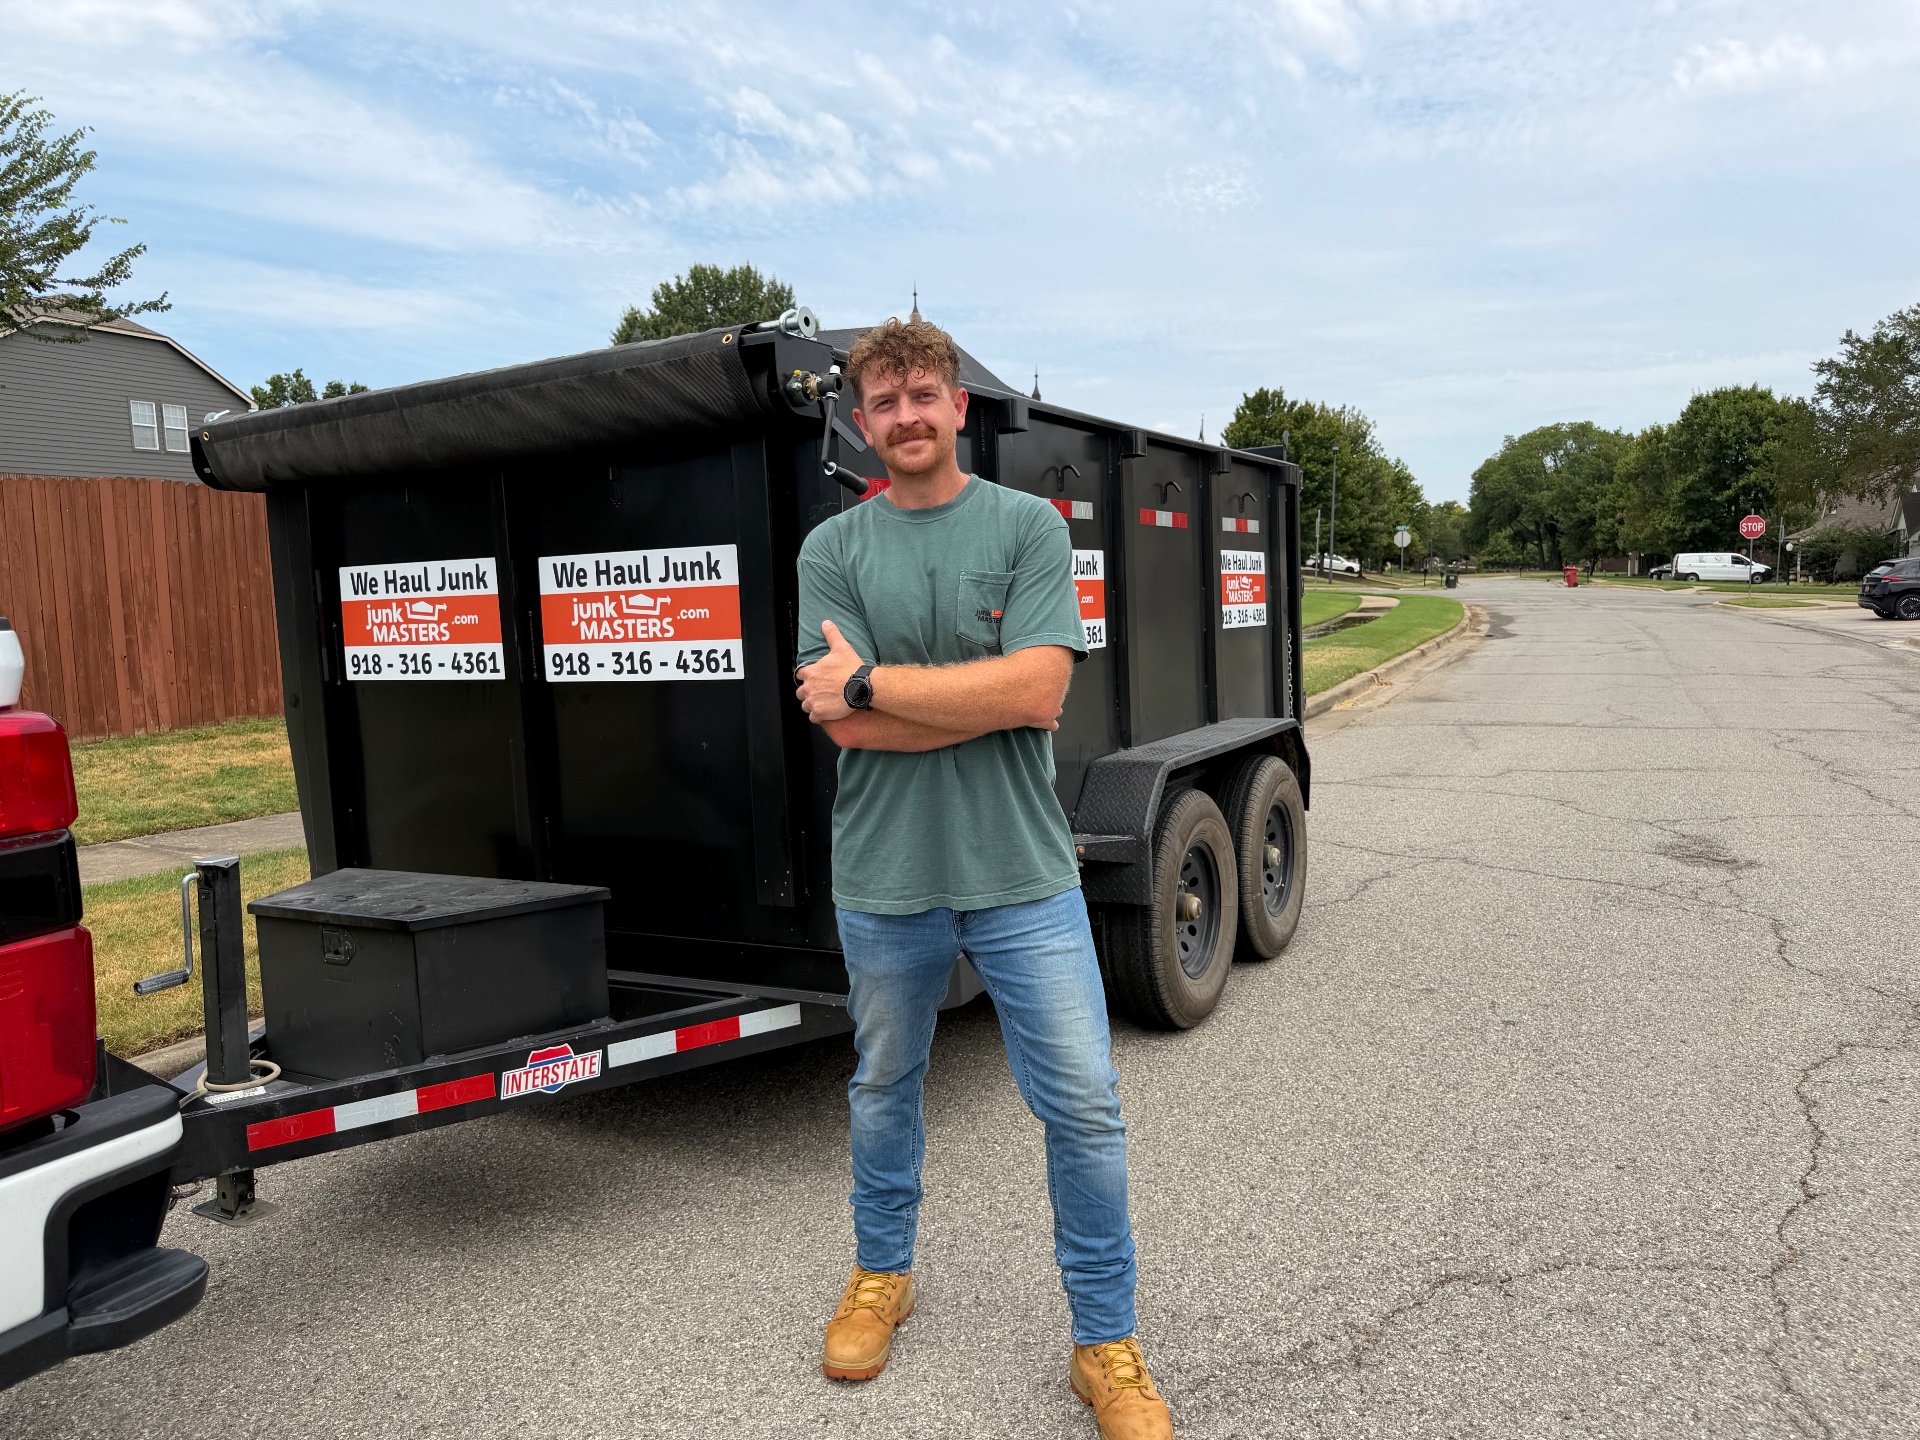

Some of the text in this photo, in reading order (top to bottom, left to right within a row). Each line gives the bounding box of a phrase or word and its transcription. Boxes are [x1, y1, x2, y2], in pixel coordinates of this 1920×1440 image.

[1742, 522, 1763, 532] STOP
[552, 551, 722, 588] We Haul Junk
[1073, 554, 1098, 576] Junk
[1221, 554, 1262, 571] We Haul Junk
[350, 563, 488, 595] We Haul Junk
[1226, 576, 1240, 594] junk
[1228, 590, 1253, 603] MASTERS
[366, 602, 404, 630] junk
[571, 595, 619, 626] junk
[579, 607, 710, 640] MASTERS .com
[373, 614, 479, 643] MASTERS .com
[1085, 625, 1103, 645] 361
[351, 653, 382, 675] 918
[399, 653, 433, 675] 316
[451, 651, 501, 674] 4361
[552, 652, 591, 676] 918
[611, 650, 653, 675] 316
[675, 649, 736, 674] 4361
[505, 1055, 598, 1095] INTERSTATE
